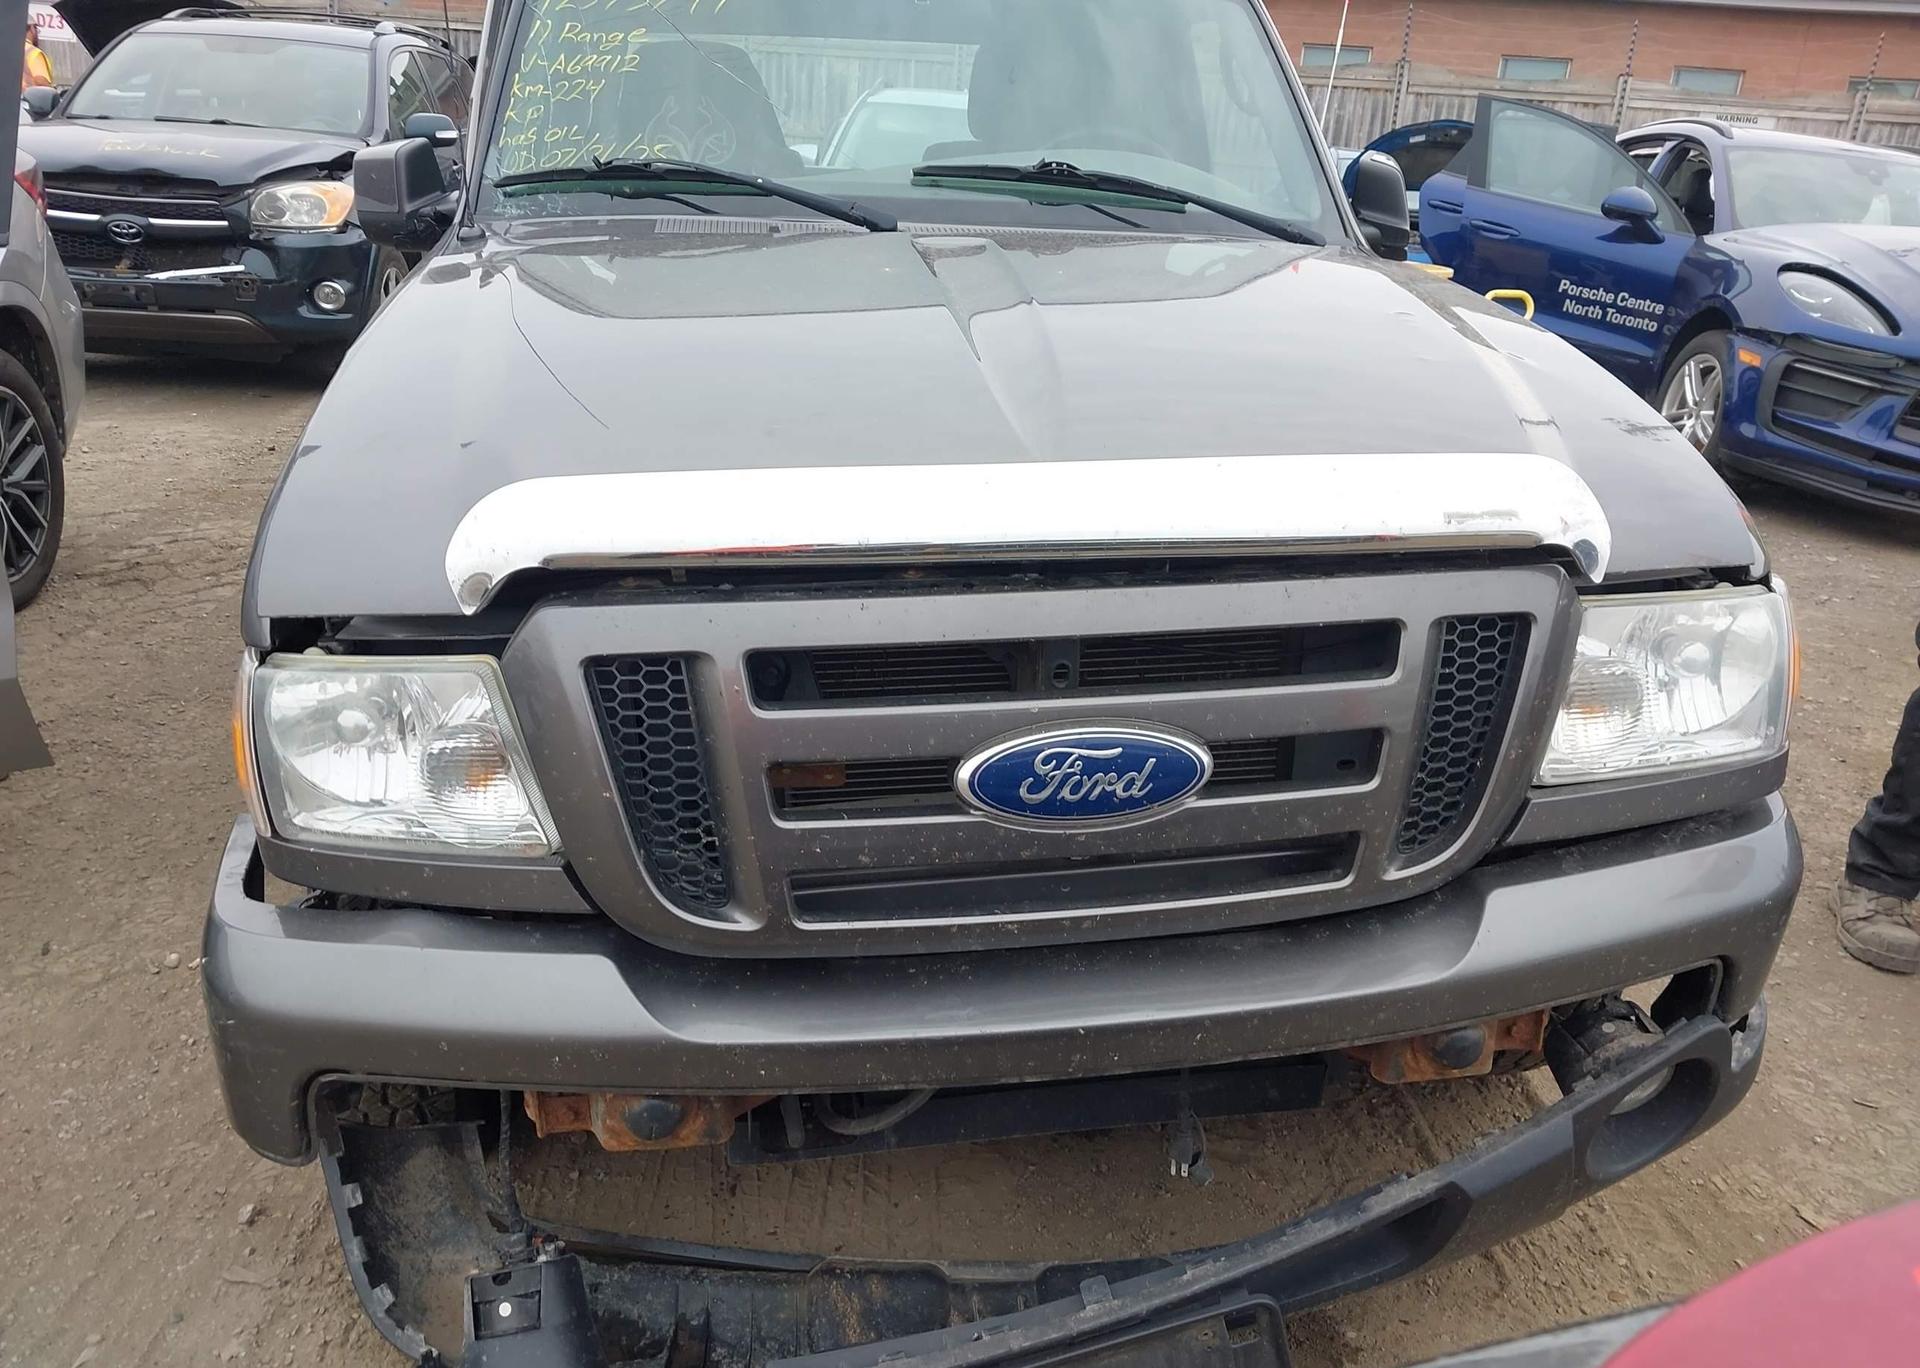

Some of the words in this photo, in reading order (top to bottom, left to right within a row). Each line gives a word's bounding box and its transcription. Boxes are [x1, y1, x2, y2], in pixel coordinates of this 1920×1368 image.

[36, 13, 65, 30] DZ3
[558, 22, 649, 51] Range
[1716, 113, 1759, 125] WARNING
[1558, 279, 1615, 304] Porsche
[1616, 291, 1665, 315] Centre
[1562, 299, 1603, 320] North
[1605, 308, 1658, 332] Toronto
[1019, 746, 1157, 804] Ford
